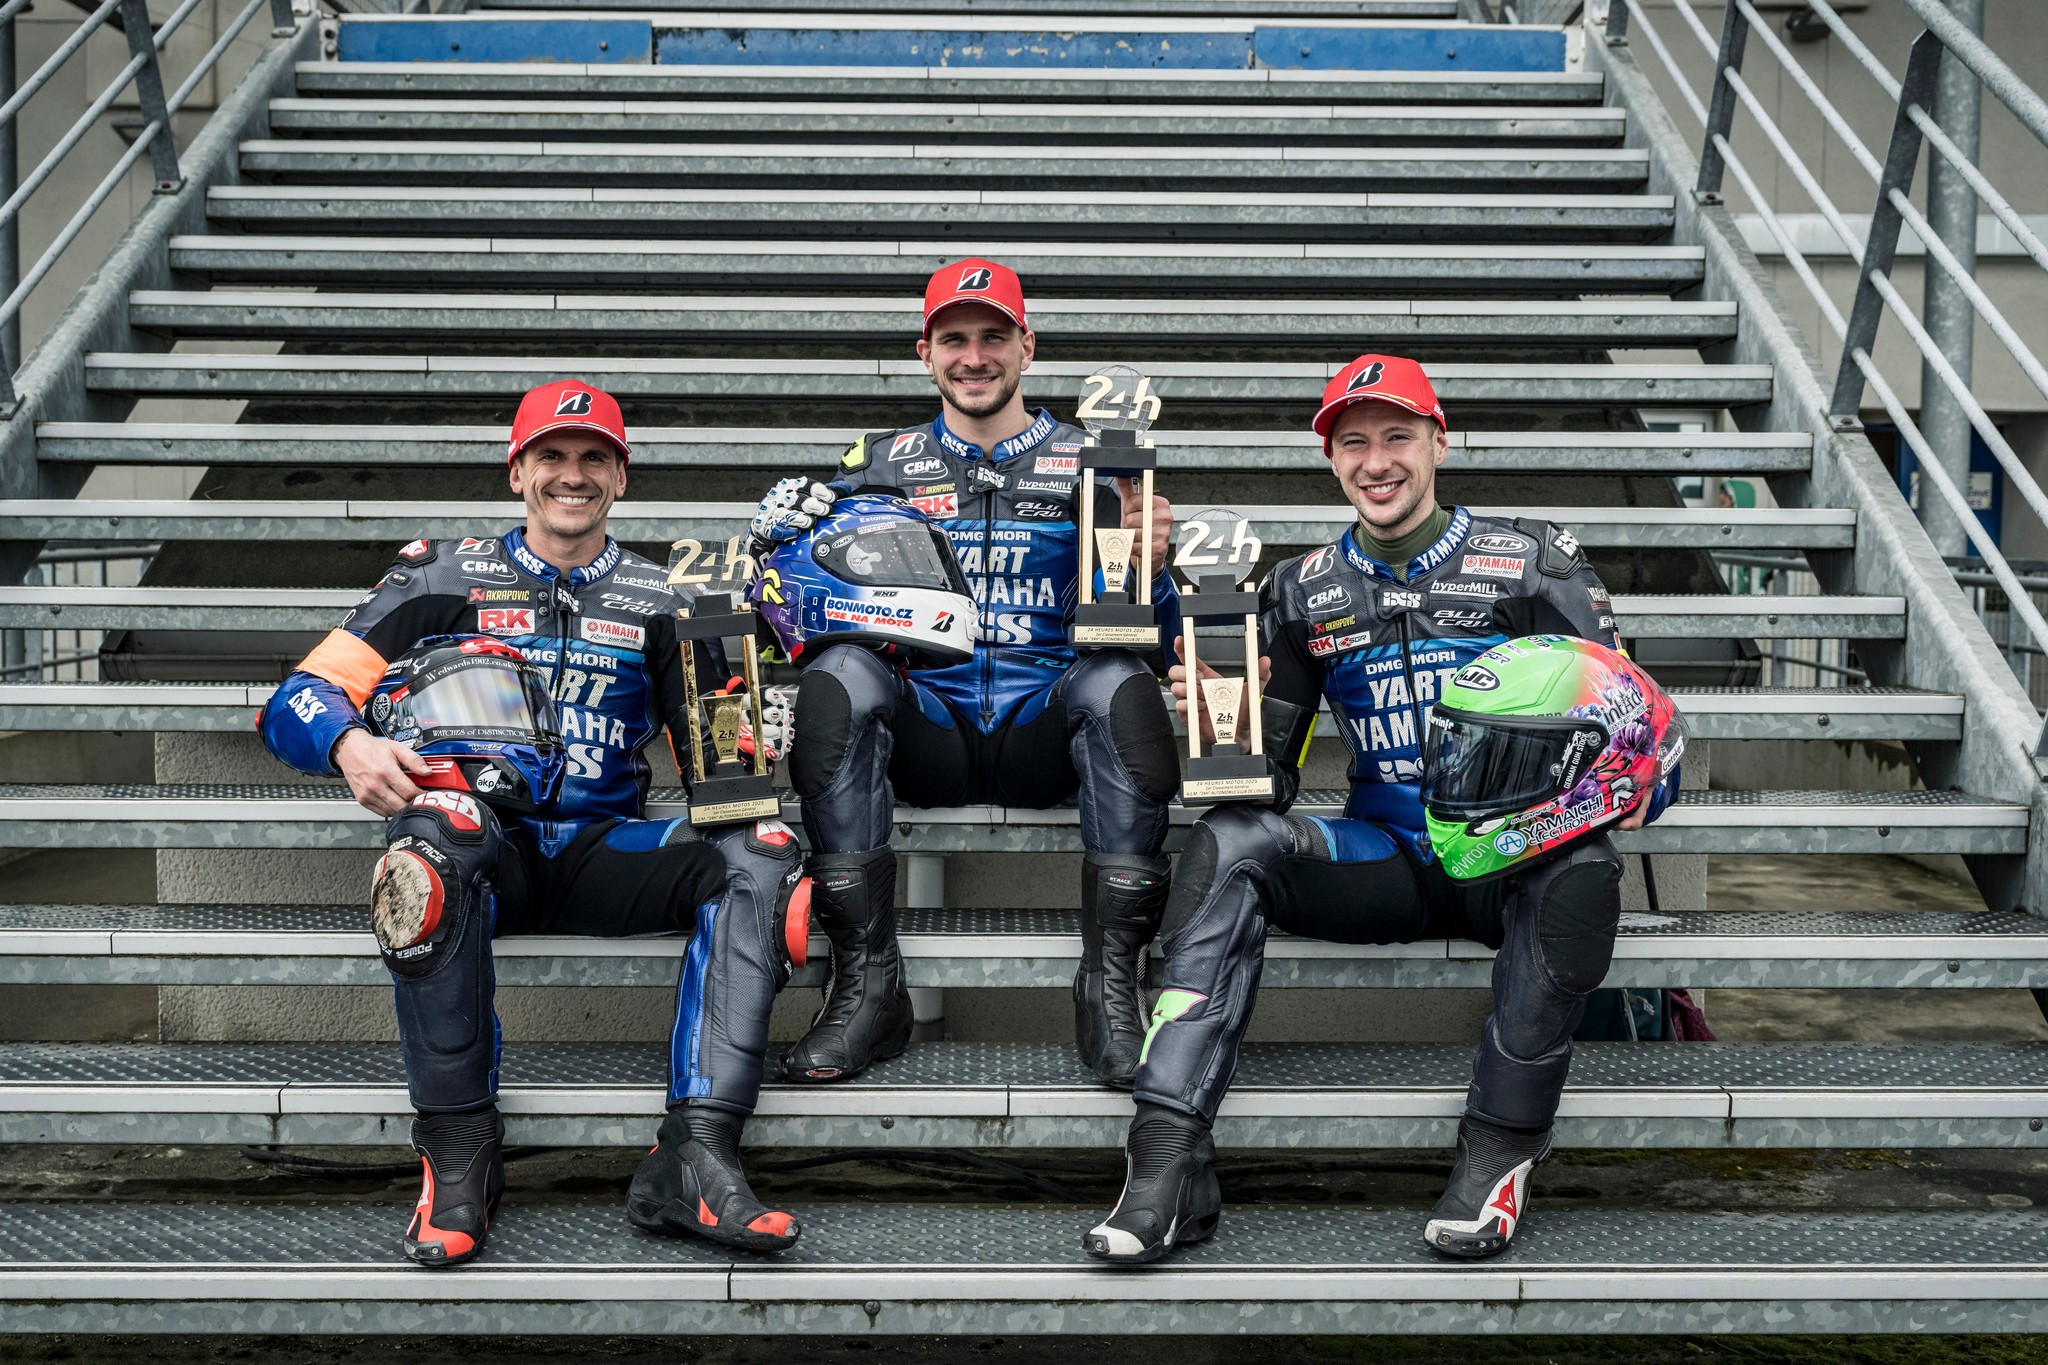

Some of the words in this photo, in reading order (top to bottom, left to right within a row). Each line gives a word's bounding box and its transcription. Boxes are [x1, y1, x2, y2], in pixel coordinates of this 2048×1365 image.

[1003, 417, 1052, 457] YAMAHA
[904, 459, 940, 475] CBM
[1017, 479, 1072, 491] hyperMILL
[912, 496, 955, 512] RK
[991, 531, 1031, 540] MORI
[1417, 513, 1471, 571] YAMAHA
[1472, 537, 1523, 549] HJC
[461, 560, 508, 574] CBM
[581, 540, 621, 582] YAMAHA
[1477, 557, 1523, 571] YAMAHA
[612, 574, 675, 592] hyperMILL
[968, 577, 1056, 607] MAHA
[1431, 580, 1497, 595] hyperMILL
[1307, 586, 1343, 609] CBM
[827, 599, 914, 619] BONMOTO.CZ
[480, 609, 534, 630] RK
[826, 611, 847, 619] VSE
[850, 614, 868, 623] NA
[874, 617, 913, 627] MOTO
[599, 622, 640, 640] YAMAHA
[1309, 637, 1333, 652] RK
[565, 651, 617, 669] MORI
[1366, 659, 1403, 675] DMG
[1412, 651, 1456, 665] MORI
[1369, 667, 1458, 710] YART
[433, 729, 465, 738] WATCHES
[467, 729, 477, 737] of
[478, 729, 525, 737] DISTINCTION
[1564, 766, 1576, 789] GERMAN
[1572, 753, 1581, 767] GUN
[478, 778, 495, 791] akp
[496, 781, 513, 791] group
[1524, 794, 1602, 837] YAMAICHI
[1529, 808, 1604, 845] ELECTRONICS
[416, 840, 447, 863] FACE
